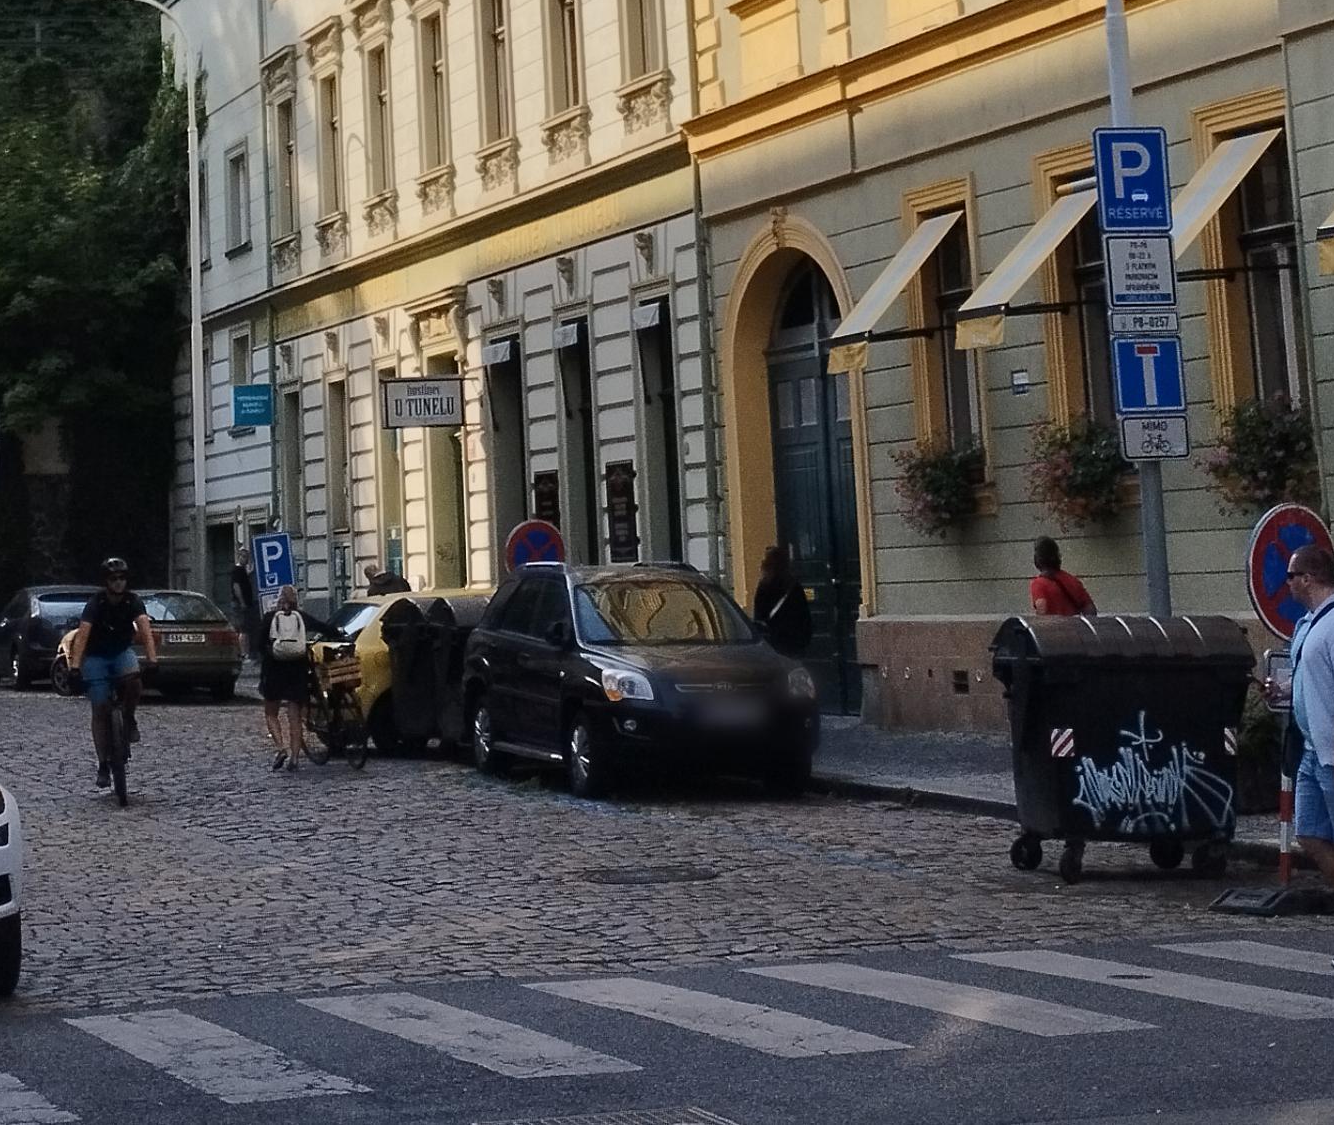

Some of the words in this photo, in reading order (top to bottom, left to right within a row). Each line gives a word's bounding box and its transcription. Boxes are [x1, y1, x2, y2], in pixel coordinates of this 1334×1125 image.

[1112, 142, 1151, 199] P
[406, 397, 454, 416] TUNELU
[1141, 420, 1168, 432] MIMO
[261, 541, 283, 573] P
